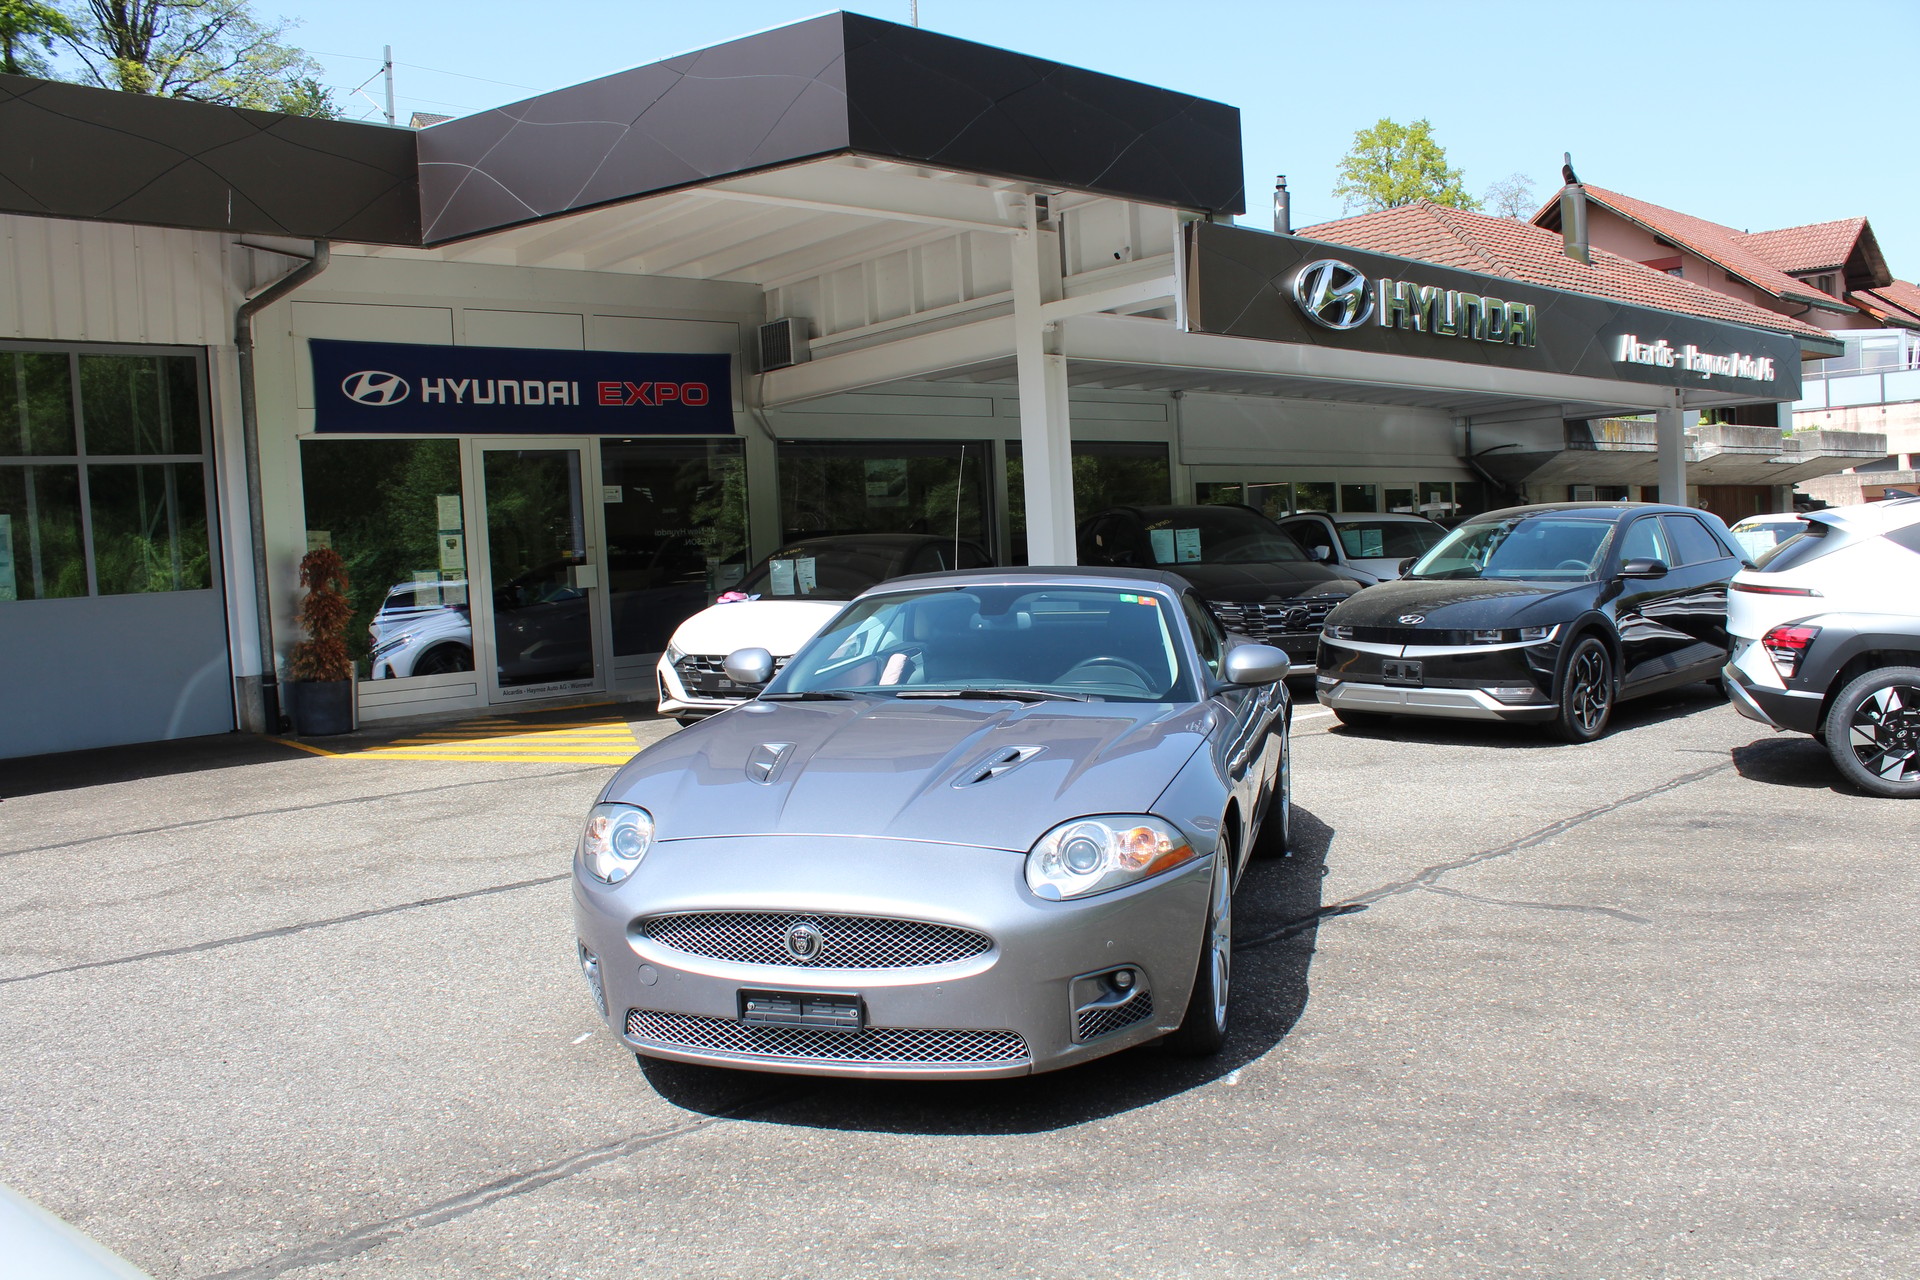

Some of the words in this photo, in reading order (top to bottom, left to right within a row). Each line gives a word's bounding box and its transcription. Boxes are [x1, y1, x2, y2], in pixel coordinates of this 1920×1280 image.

[1379, 278, 1536, 347] HYUNDAI
[421, 377, 579, 405] HYUNDAI
[598, 381, 709, 406] EXPO
